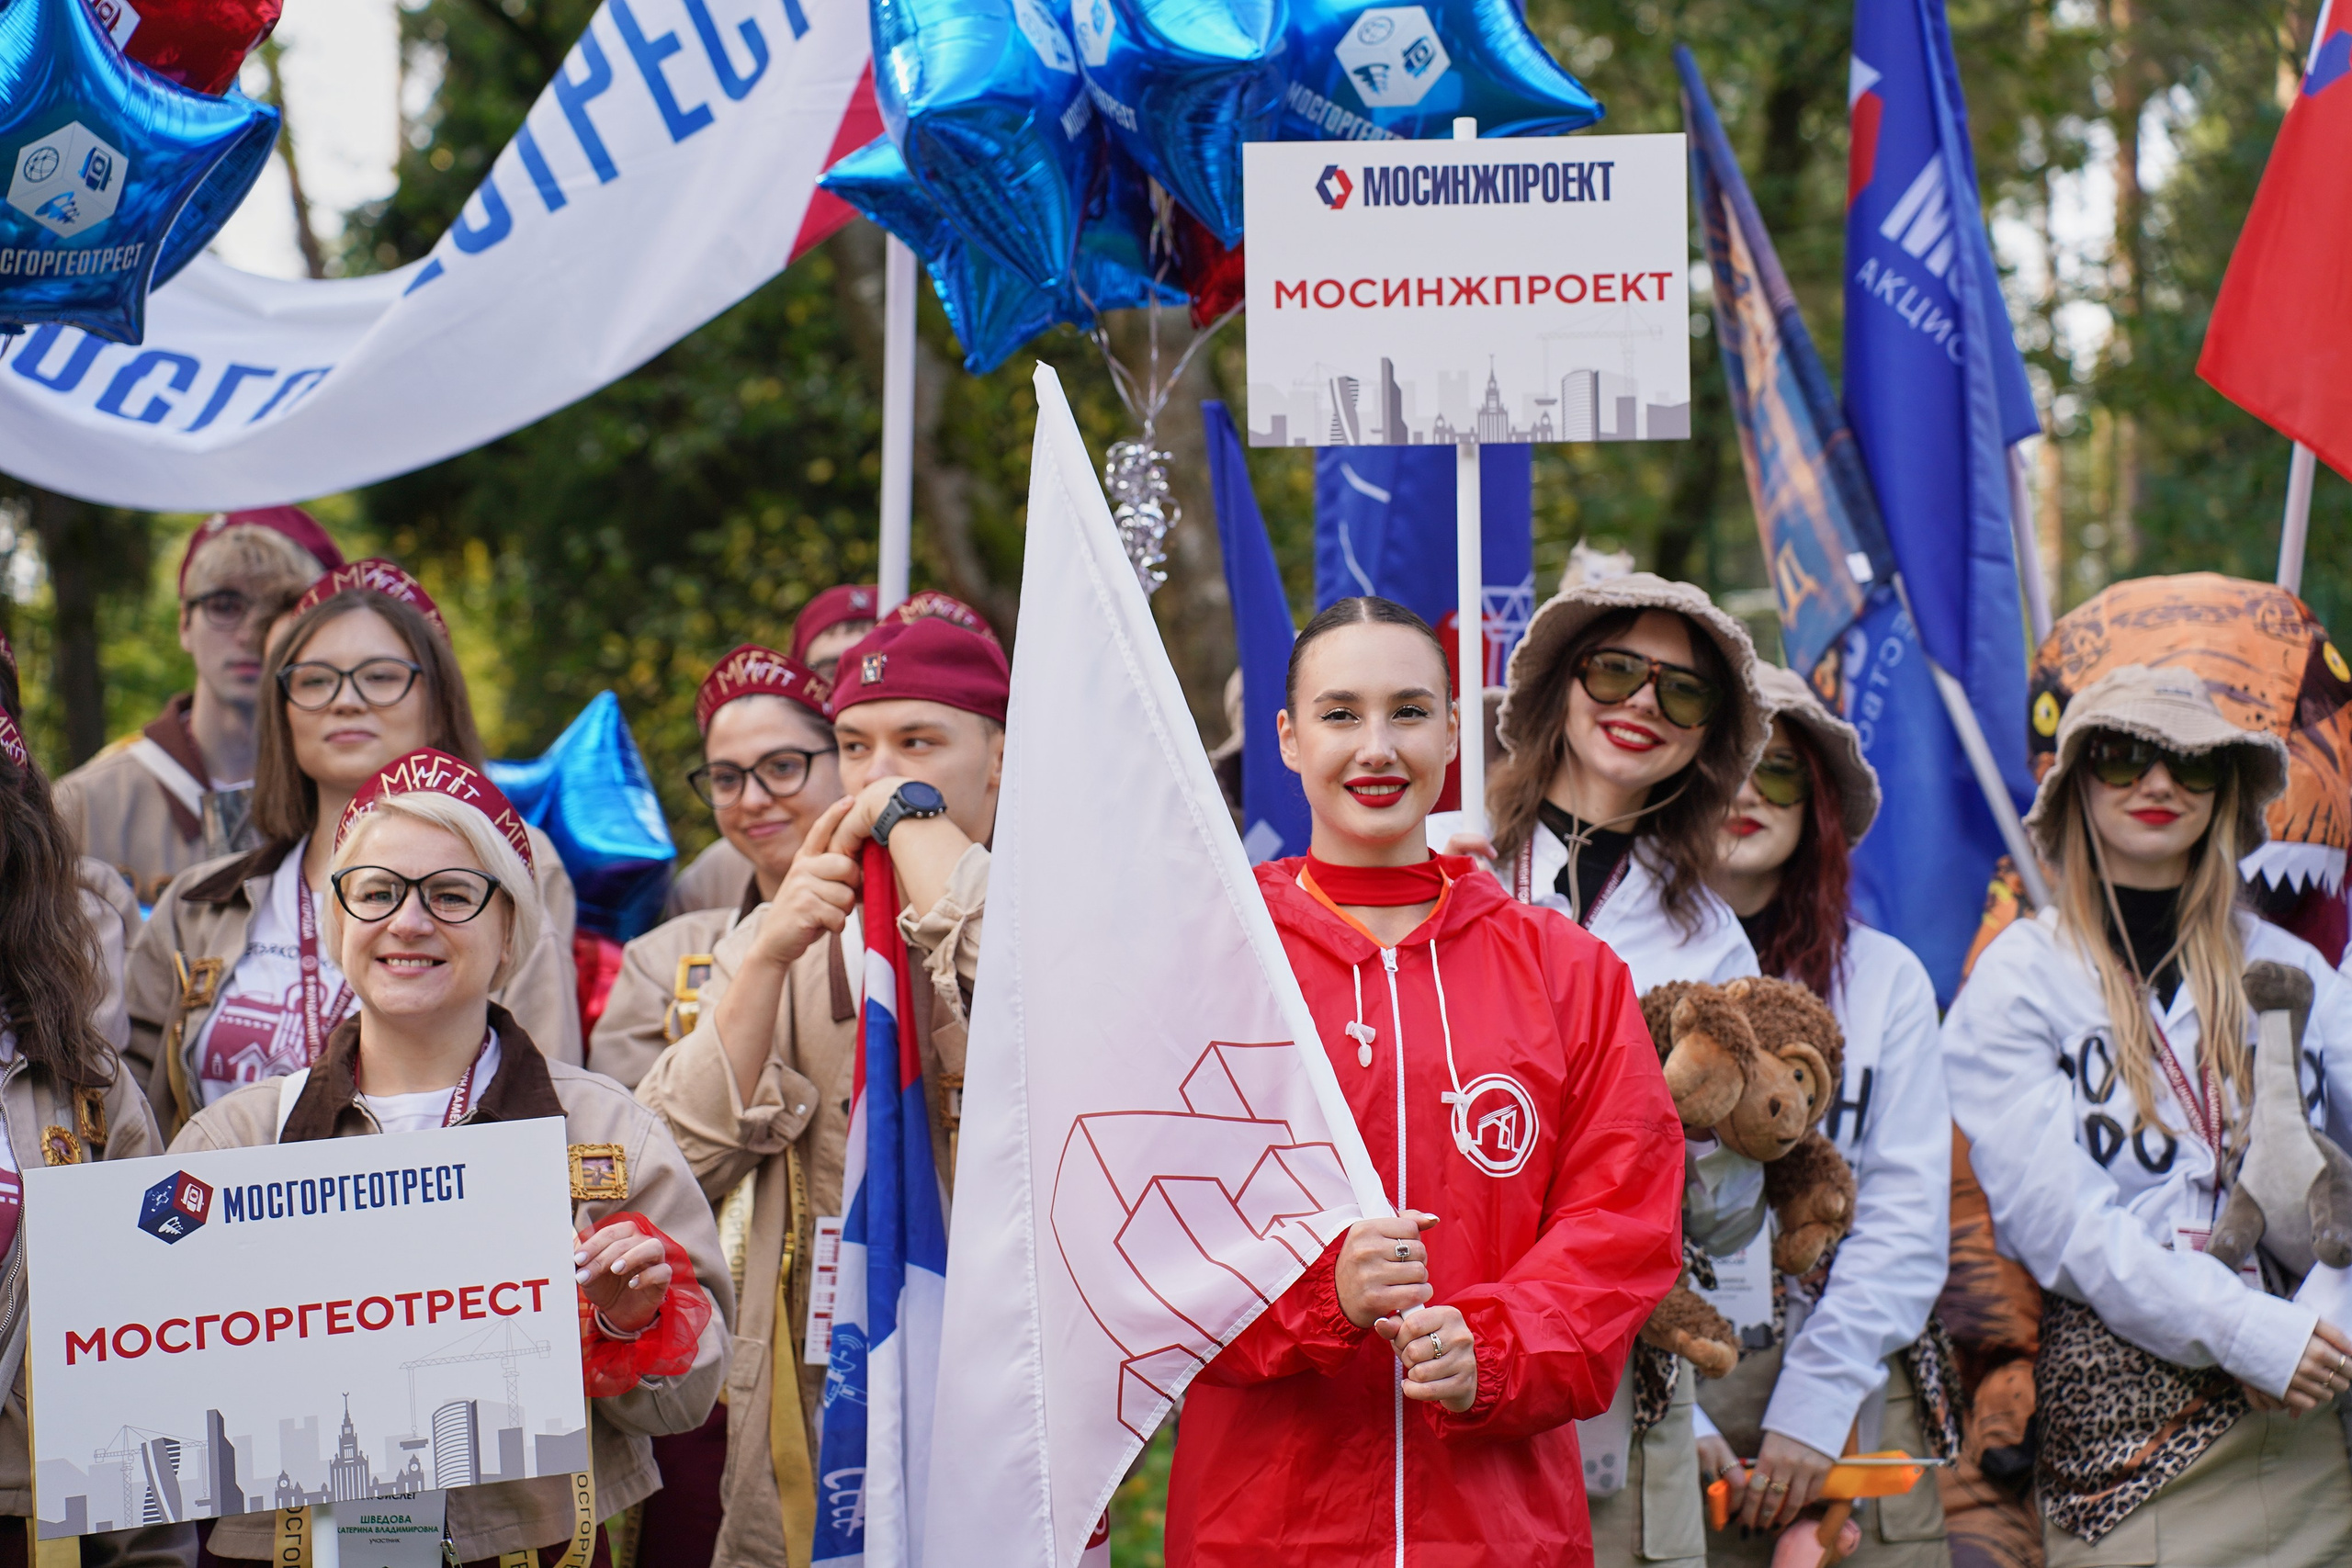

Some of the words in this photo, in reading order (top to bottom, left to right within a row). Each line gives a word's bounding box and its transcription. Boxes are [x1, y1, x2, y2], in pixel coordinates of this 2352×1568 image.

[1363, 162, 1614, 207] МОСИНЖПРОЕКТ
[0, 243, 145, 276] СГОРГЕОТРЕСТ
[1274, 272, 1672, 309] МОСИНЖПРОЕКТ
[223, 1163, 467, 1224] МОСГОРГЕОТРЕСТ
[65, 1279, 550, 1366] МОСГОРГЕОТРЕСТ
[360, 1515, 413, 1525] ШВЕДОВА
[375, 1526, 439, 1534] ВЛАДИМИРОВНА
